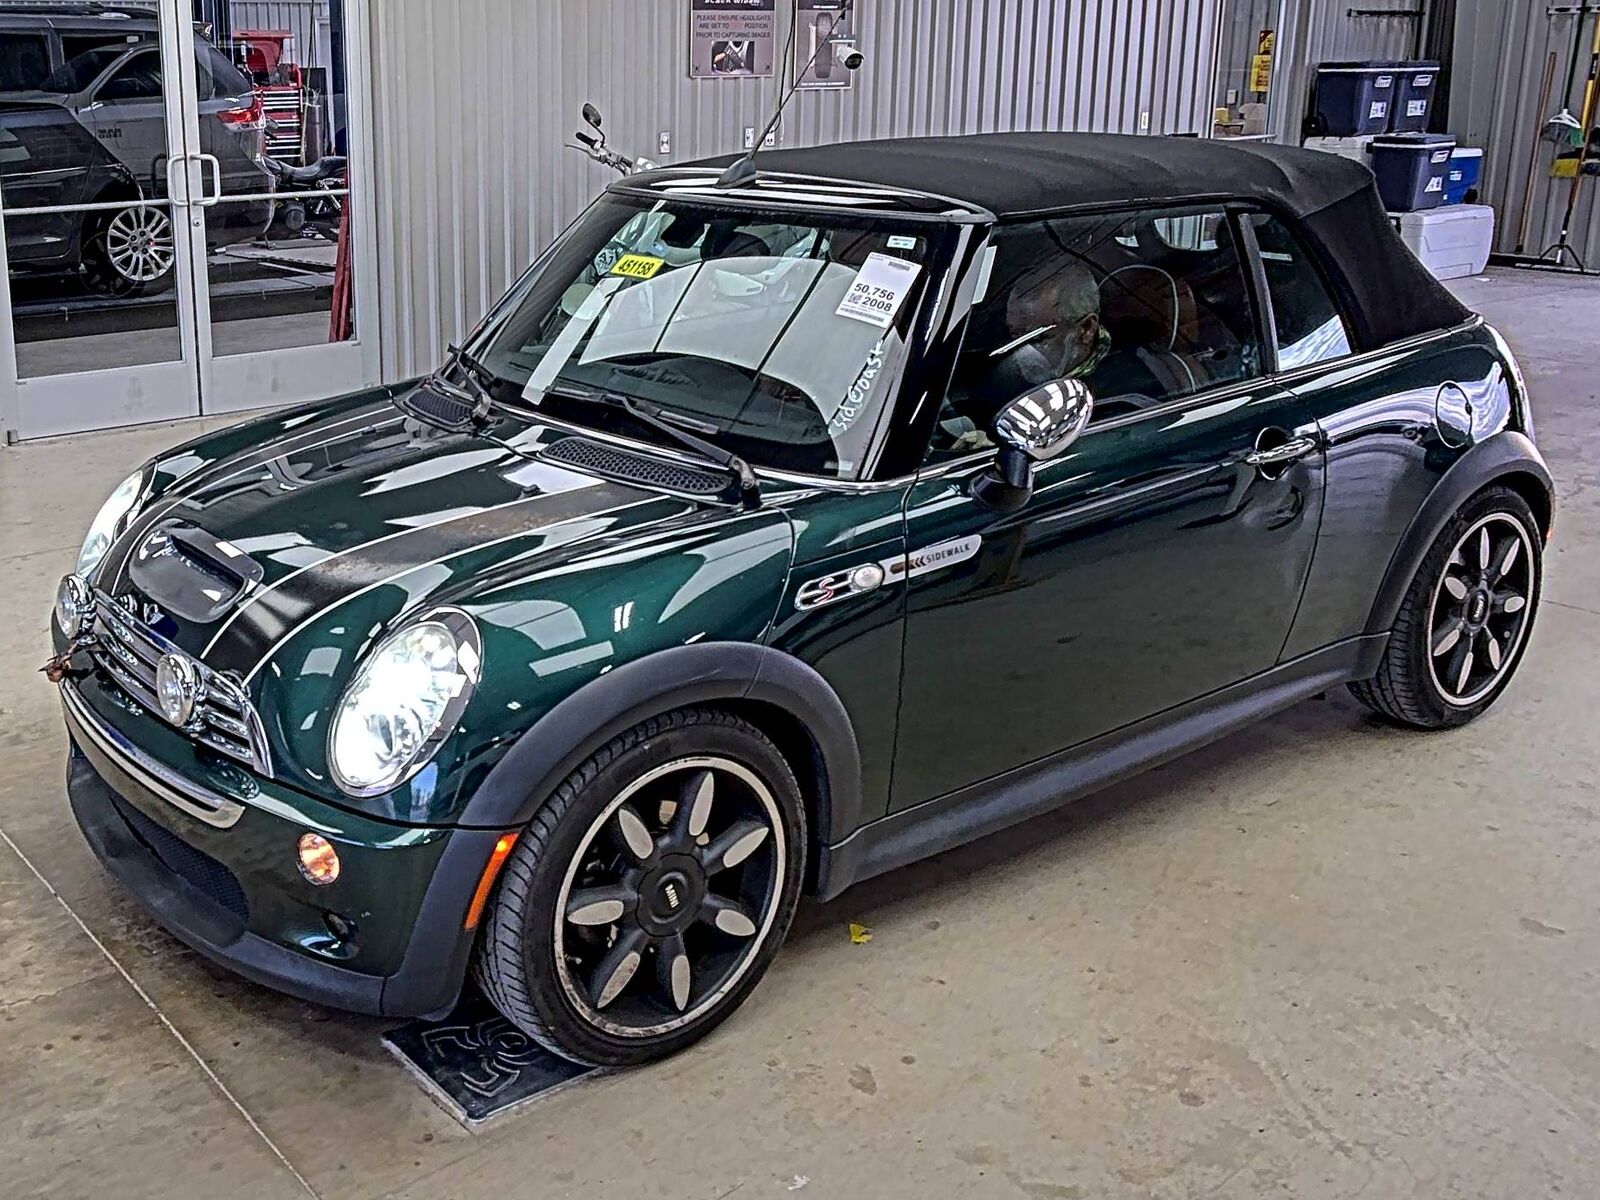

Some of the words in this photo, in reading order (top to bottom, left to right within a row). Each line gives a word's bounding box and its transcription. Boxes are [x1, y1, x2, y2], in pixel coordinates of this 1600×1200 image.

[618, 259, 655, 275] 451158
[862, 297, 893, 312] 2008
[926, 543, 970, 563] SIDEWALK
[665, 883, 680, 908] MINI
